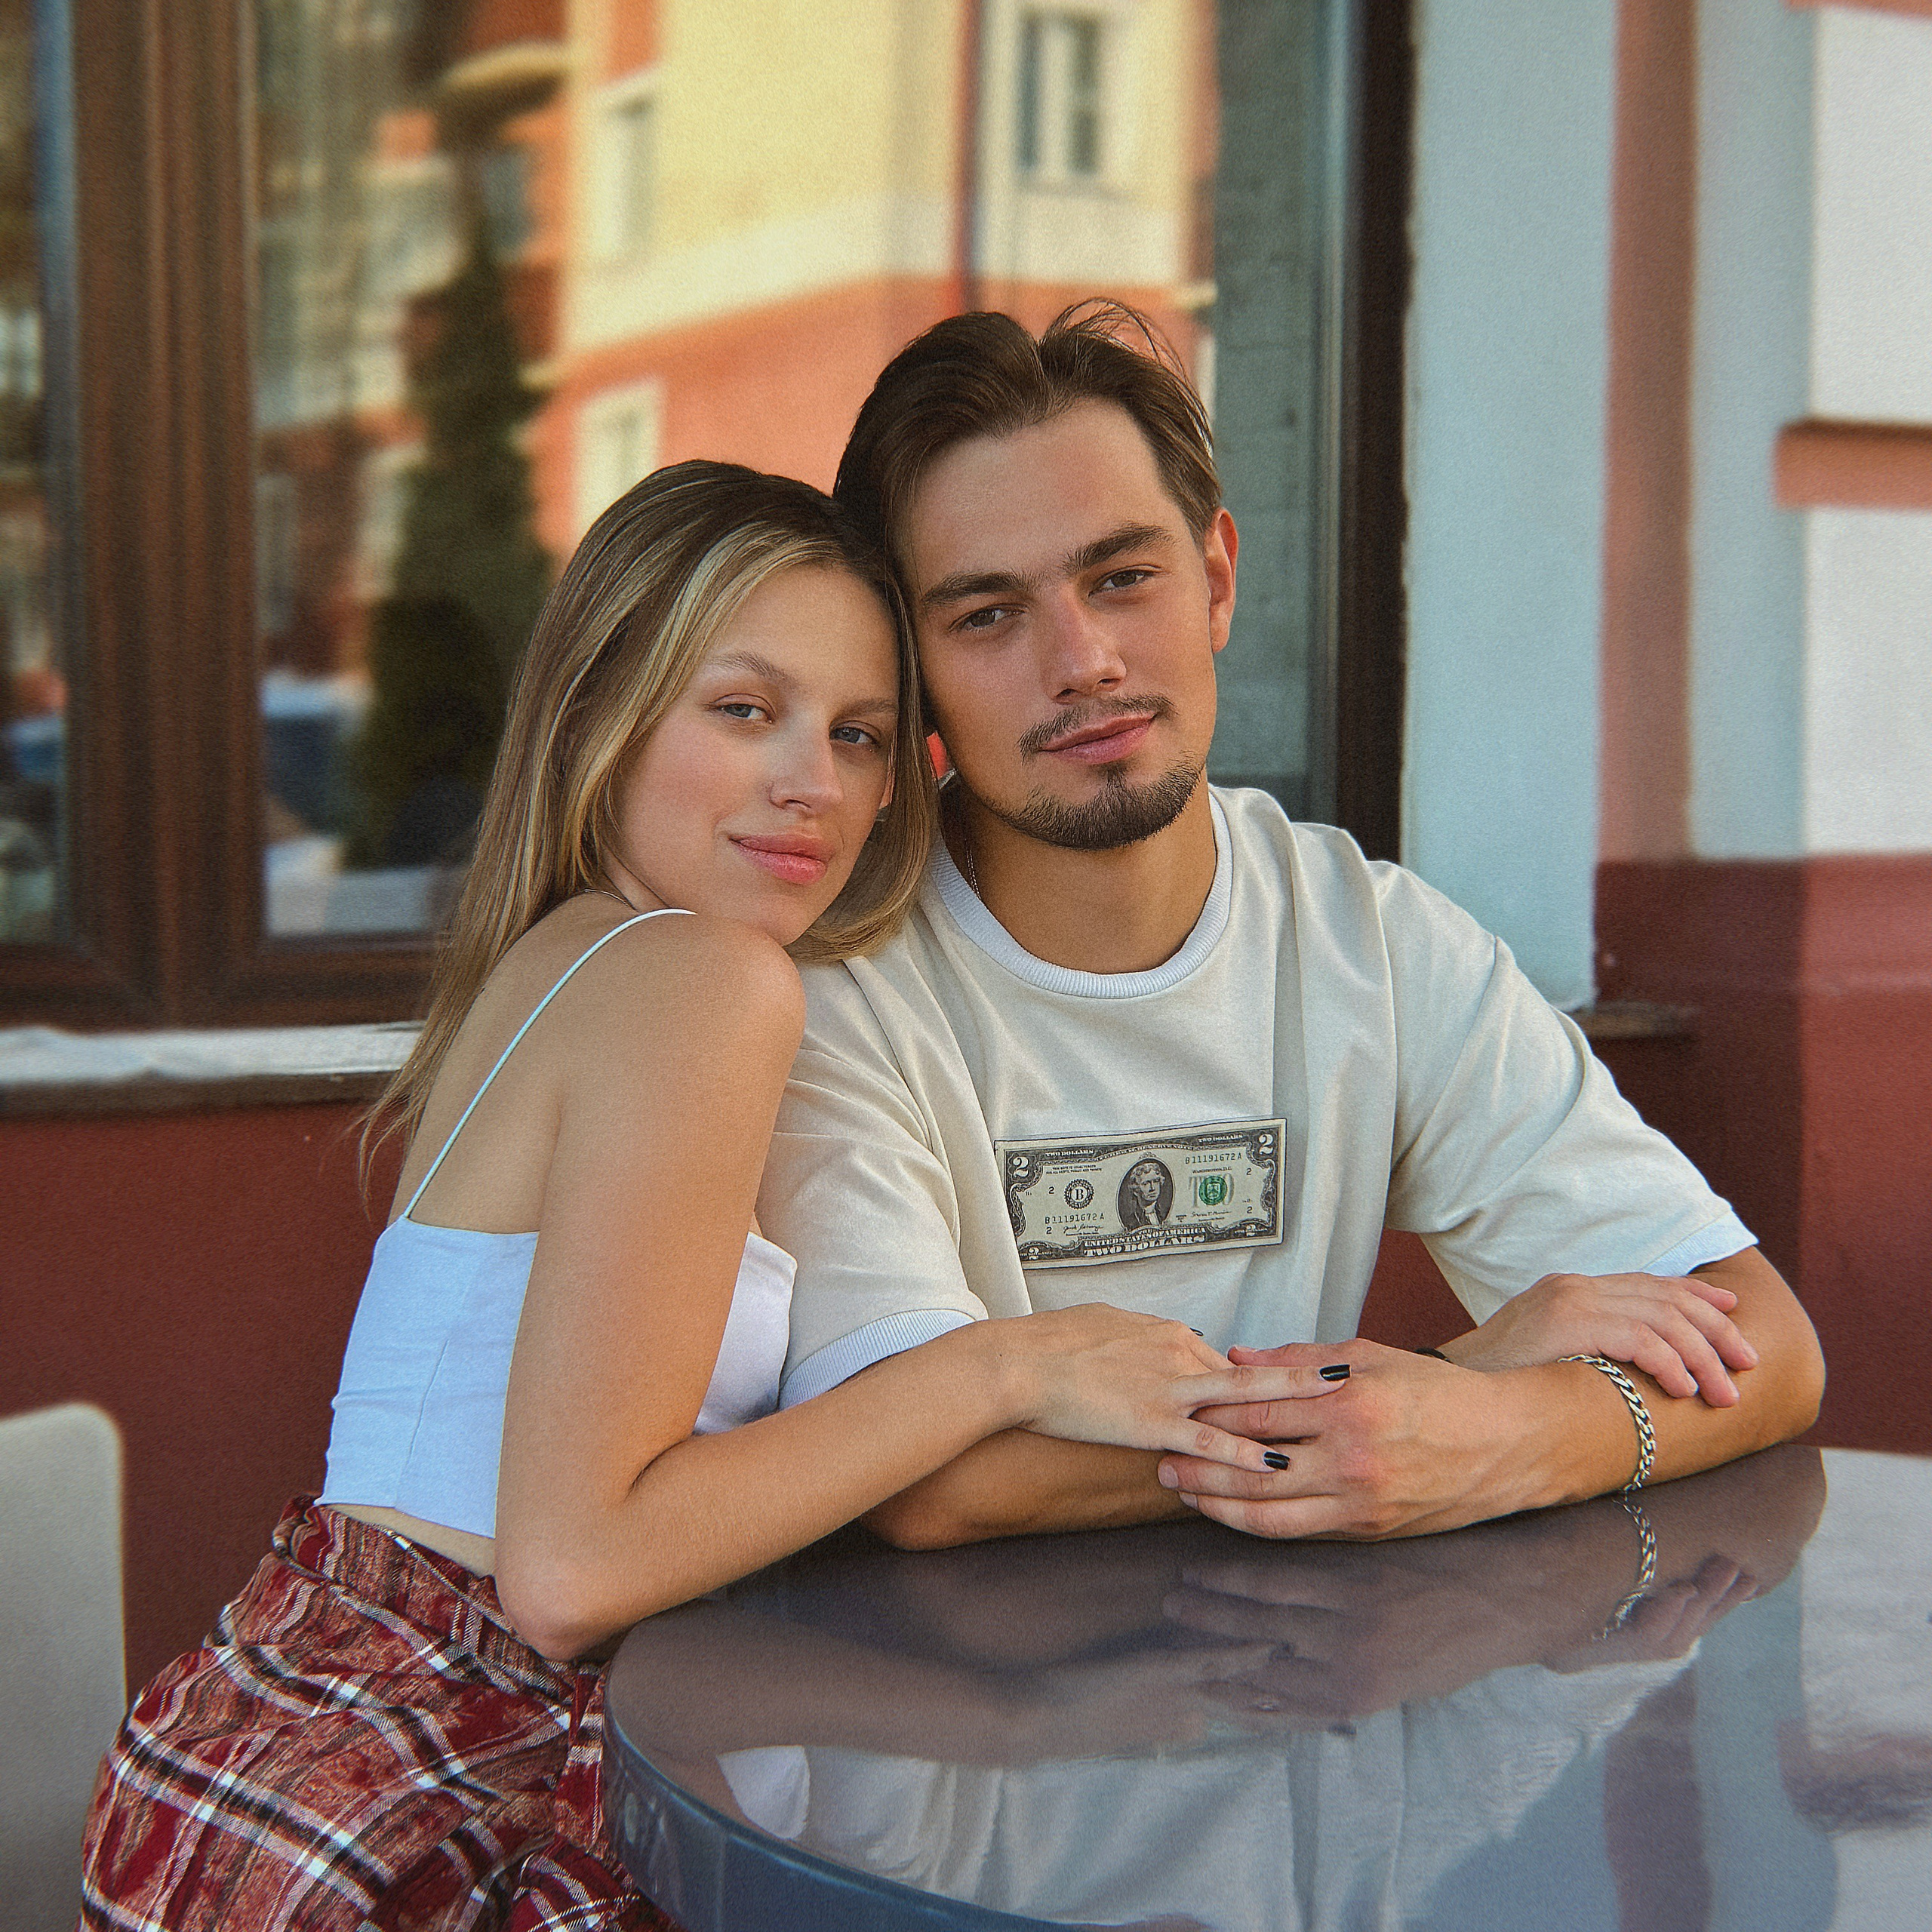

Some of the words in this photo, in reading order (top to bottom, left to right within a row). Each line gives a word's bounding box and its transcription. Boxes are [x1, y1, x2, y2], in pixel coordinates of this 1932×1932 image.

[1258, 1134, 1273, 1155] 2
[1013, 1156, 1029, 1177] 2
[1246, 1168, 1252, 1176] 2
[1048, 1186, 1055, 1195] 2
[1075, 1189, 1084, 1200] B
[1246, 1206, 1253, 1214] 2
[1046, 1226, 1052, 1235] 2
[1084, 1246, 1122, 1256] TWO
[1124, 1235, 1205, 1252] DOLLARS
